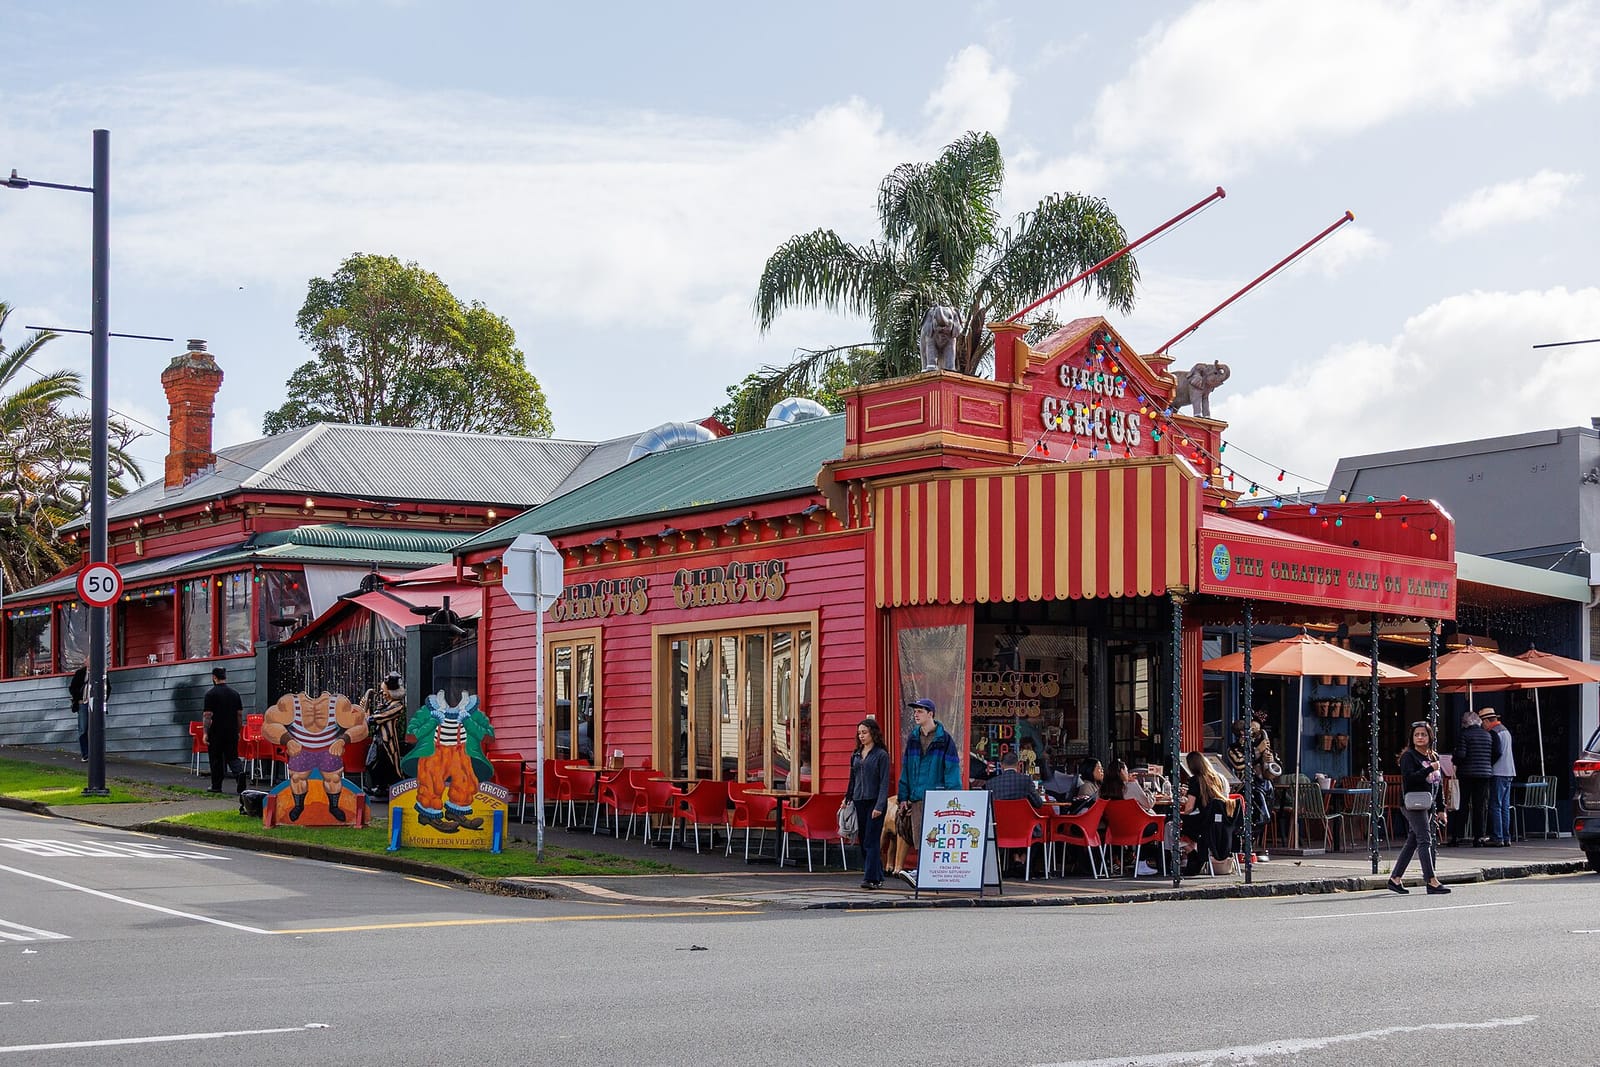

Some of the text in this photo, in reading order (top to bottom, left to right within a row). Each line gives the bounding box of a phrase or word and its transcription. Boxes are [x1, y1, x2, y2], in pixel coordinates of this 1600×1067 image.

[1060, 364, 1125, 398] CIRCUS
[1042, 396, 1141, 446] CIRCUS
[89, 576, 114, 593] 50
[673, 559, 786, 609] CIRCUS
[1234, 556, 1449, 599] THE GREATEST CAFE ON EARTH
[988, 724, 1022, 739] KIDS
[391, 779, 419, 797] CIRCUS
[479, 782, 508, 800] CIRCUS
[474, 793, 502, 810] CAFE
[937, 823, 970, 835] KIDS
[409, 837, 434, 846] MOUNT
[436, 838, 456, 847] EDEN
[937, 837, 967, 849] EAT
[933, 851, 969, 863] FREE
